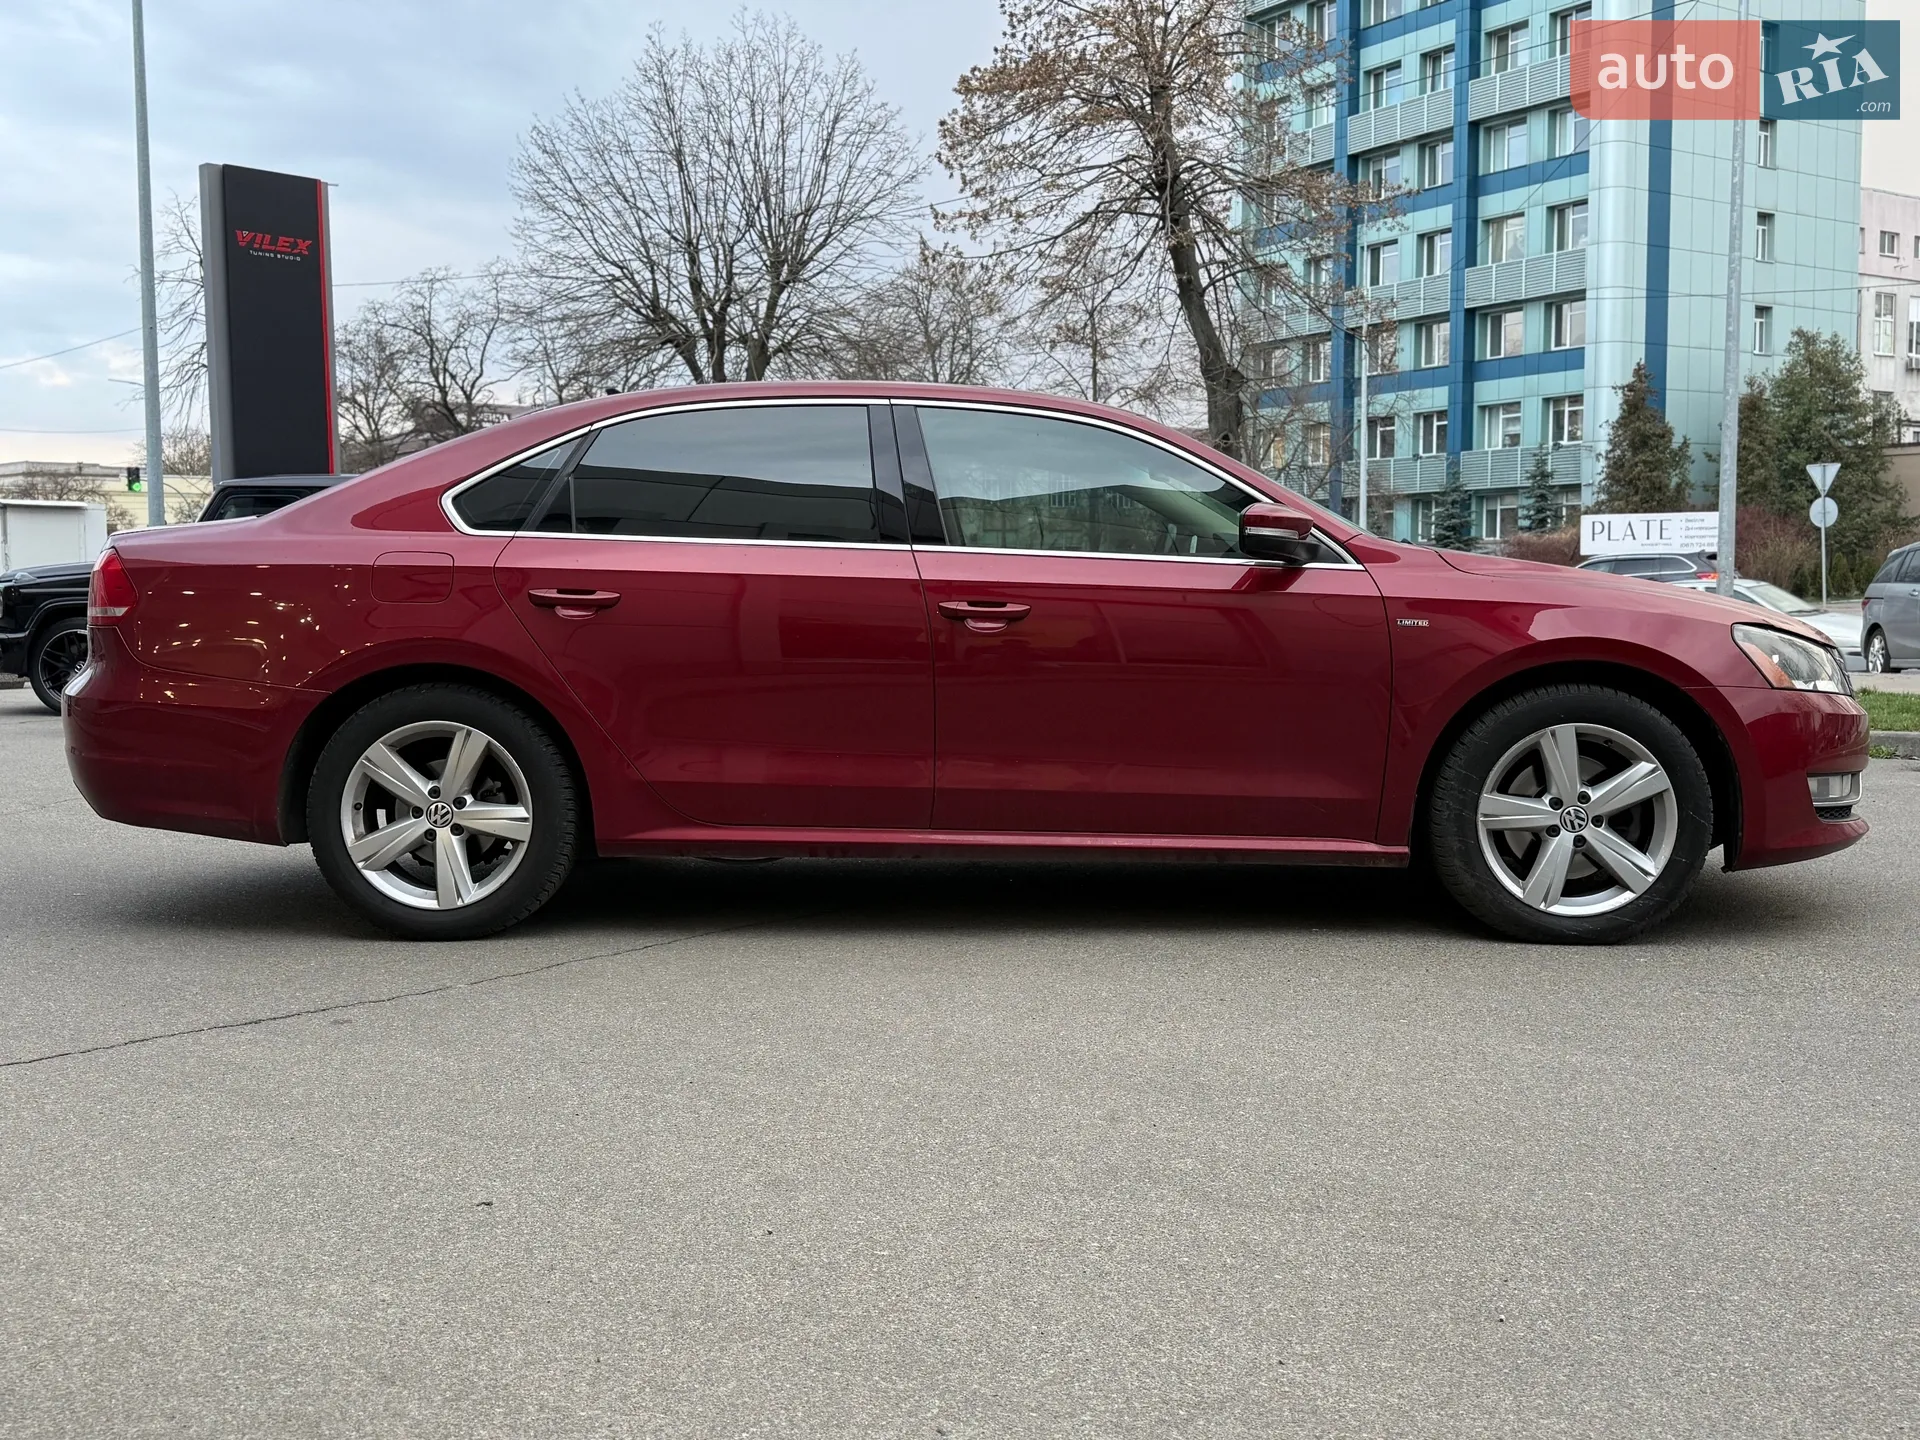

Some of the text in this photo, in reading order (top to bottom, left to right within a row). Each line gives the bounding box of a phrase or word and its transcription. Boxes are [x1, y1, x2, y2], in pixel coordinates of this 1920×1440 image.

[235, 230, 312, 254] VILEX
[249, 250, 301, 262] TUNING STUDIO
[1591, 519, 1672, 541] PLATE
[1396, 618, 1430, 627] LIMITED
